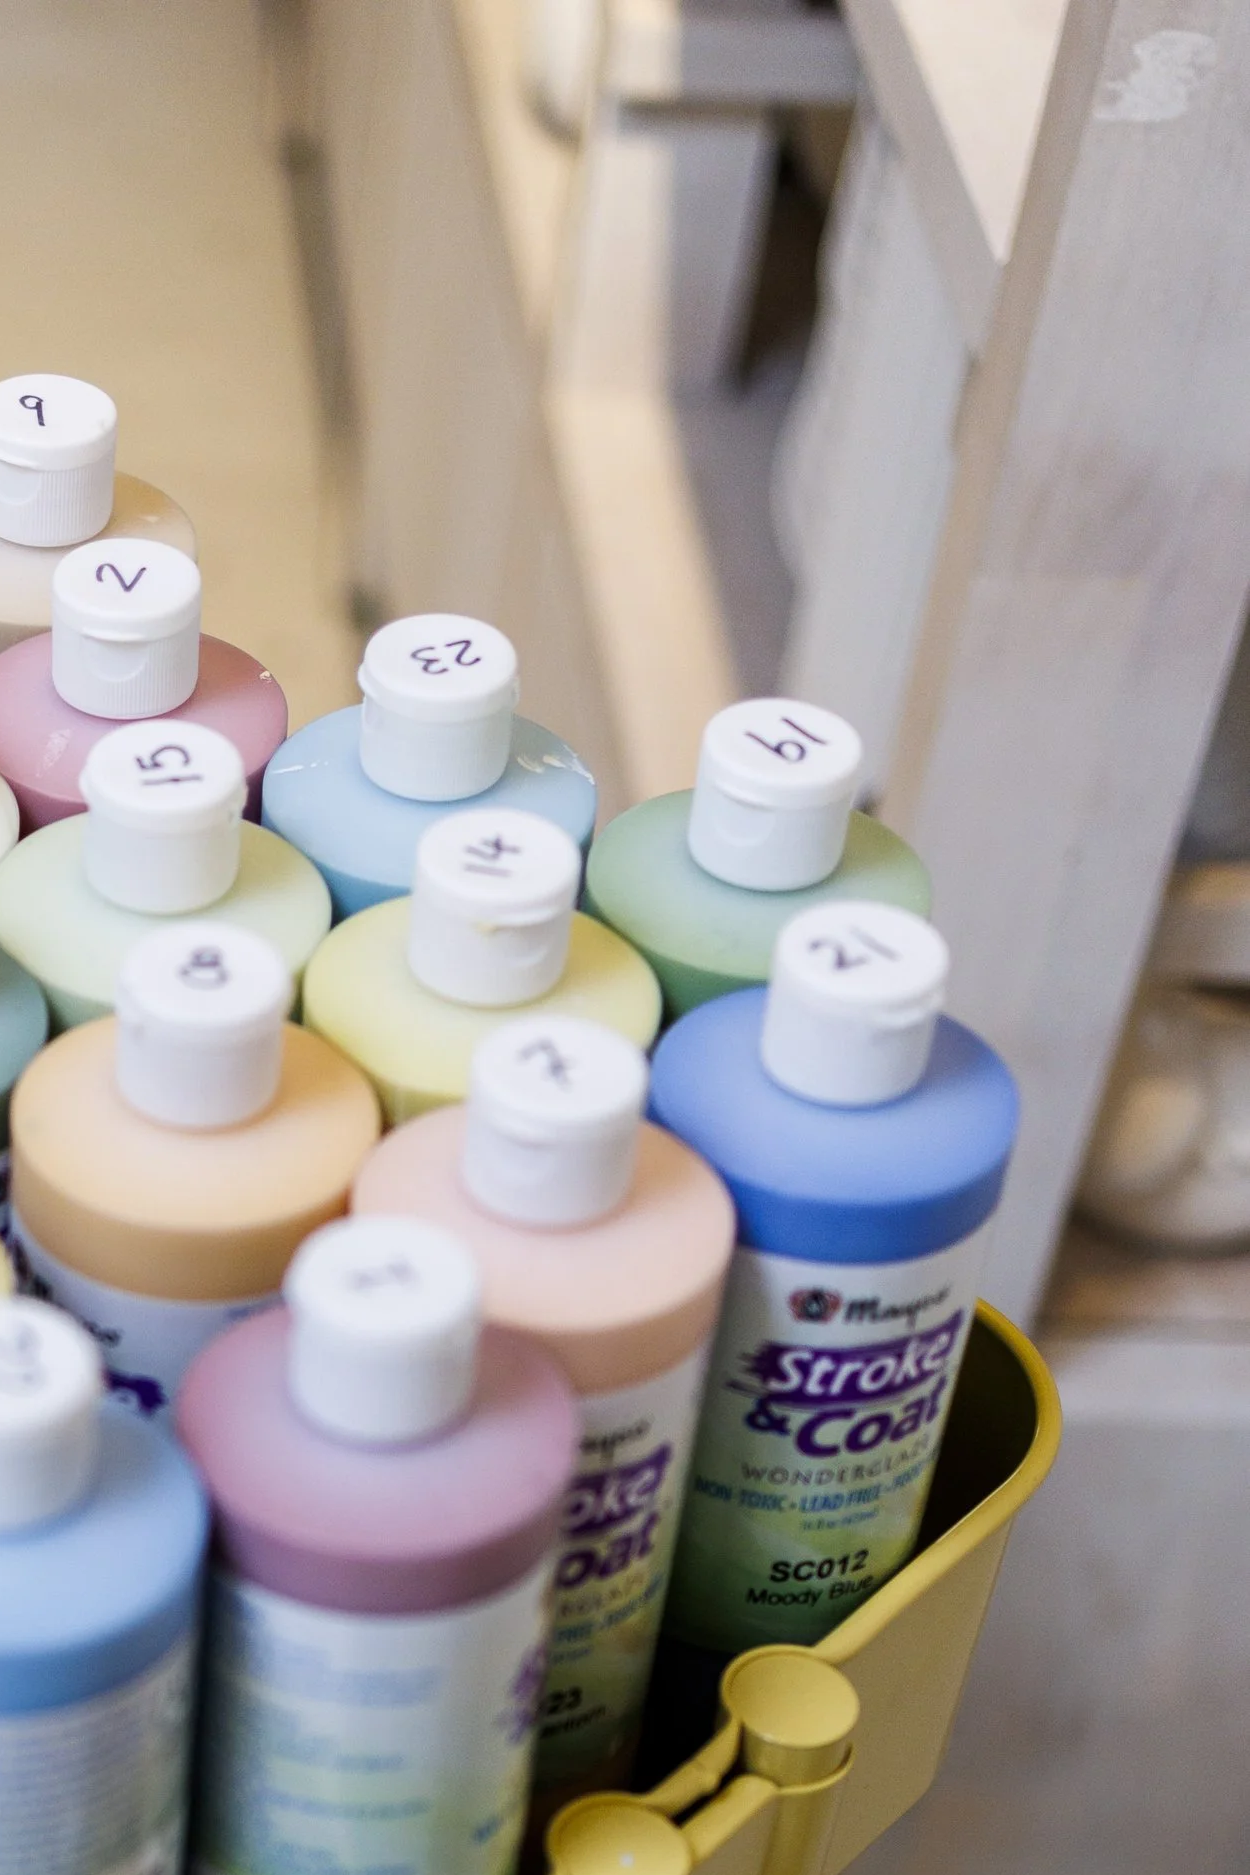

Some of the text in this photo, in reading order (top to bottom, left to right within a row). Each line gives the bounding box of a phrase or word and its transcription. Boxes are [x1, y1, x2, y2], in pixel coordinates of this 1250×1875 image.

[19, 395, 47, 427] 9
[95, 562, 147, 593] 2
[410, 639, 482, 676] 23
[135, 744, 203, 786] 15
[462, 833, 522, 878] 14
[807, 926, 901, 971] 21
[765, 1332, 950, 1397] Stroke
[743, 1376, 948, 1458] & Coat
[769, 1548, 870, 1583] SC012
[746, 1575, 873, 1608] Moody Blue
